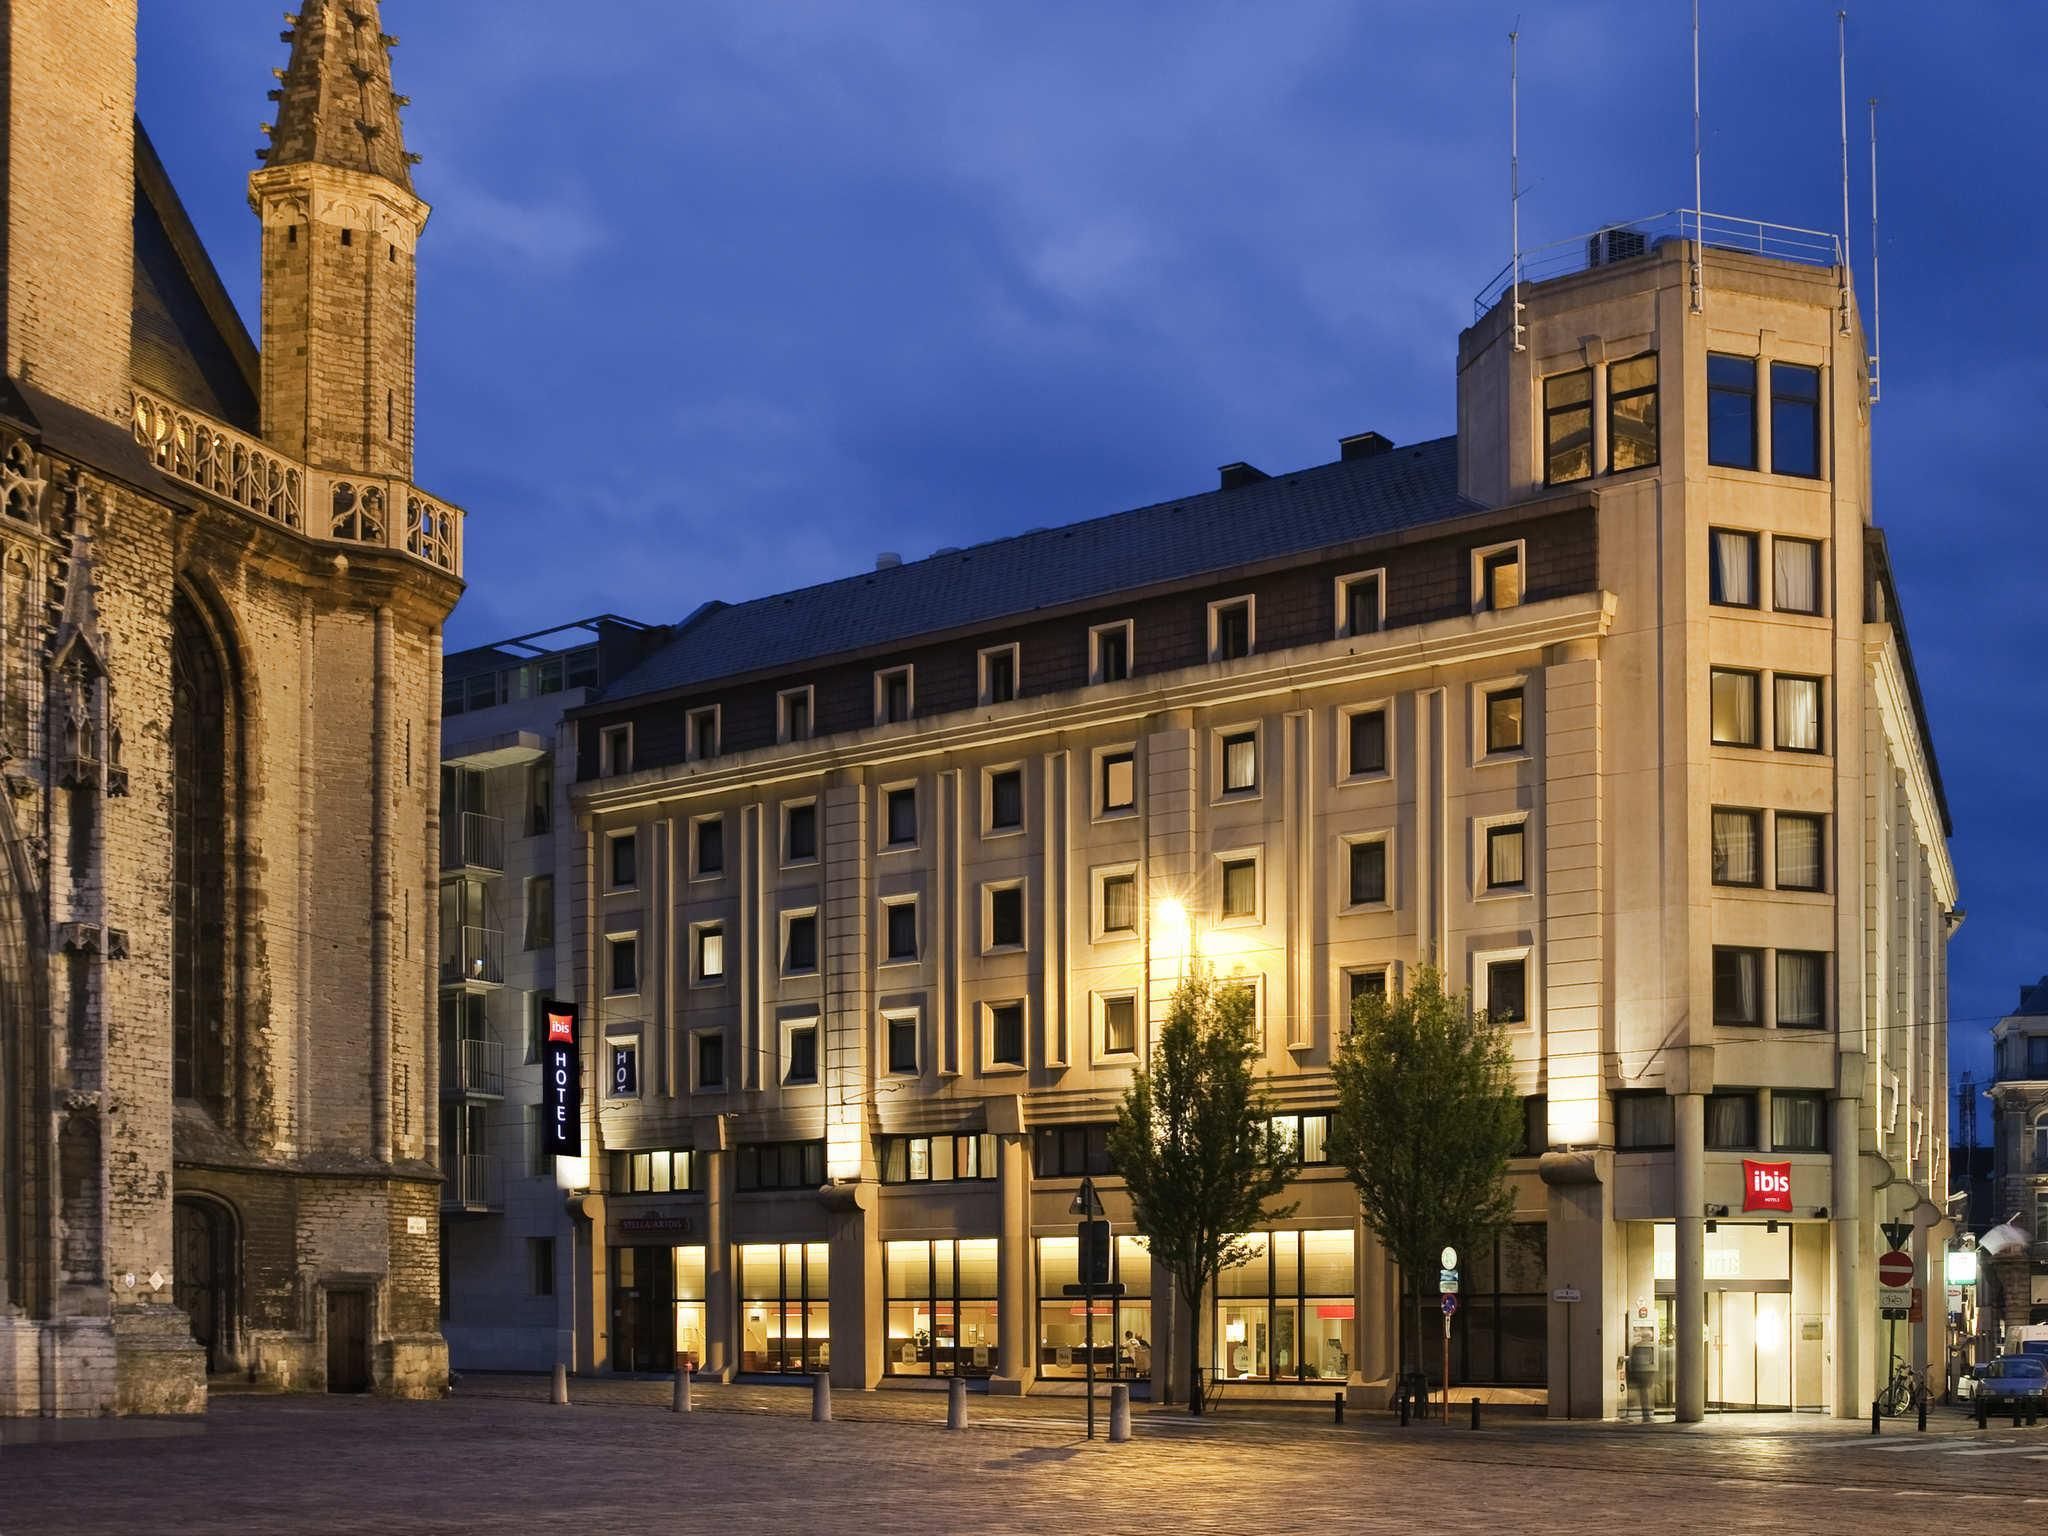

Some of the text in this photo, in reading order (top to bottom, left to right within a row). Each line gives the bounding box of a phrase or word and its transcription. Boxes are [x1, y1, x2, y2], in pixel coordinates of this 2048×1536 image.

[552, 1021, 569, 1034] ibis
[555, 1051, 567, 1140] HOTEL
[1754, 1170, 1789, 1192] ibis
